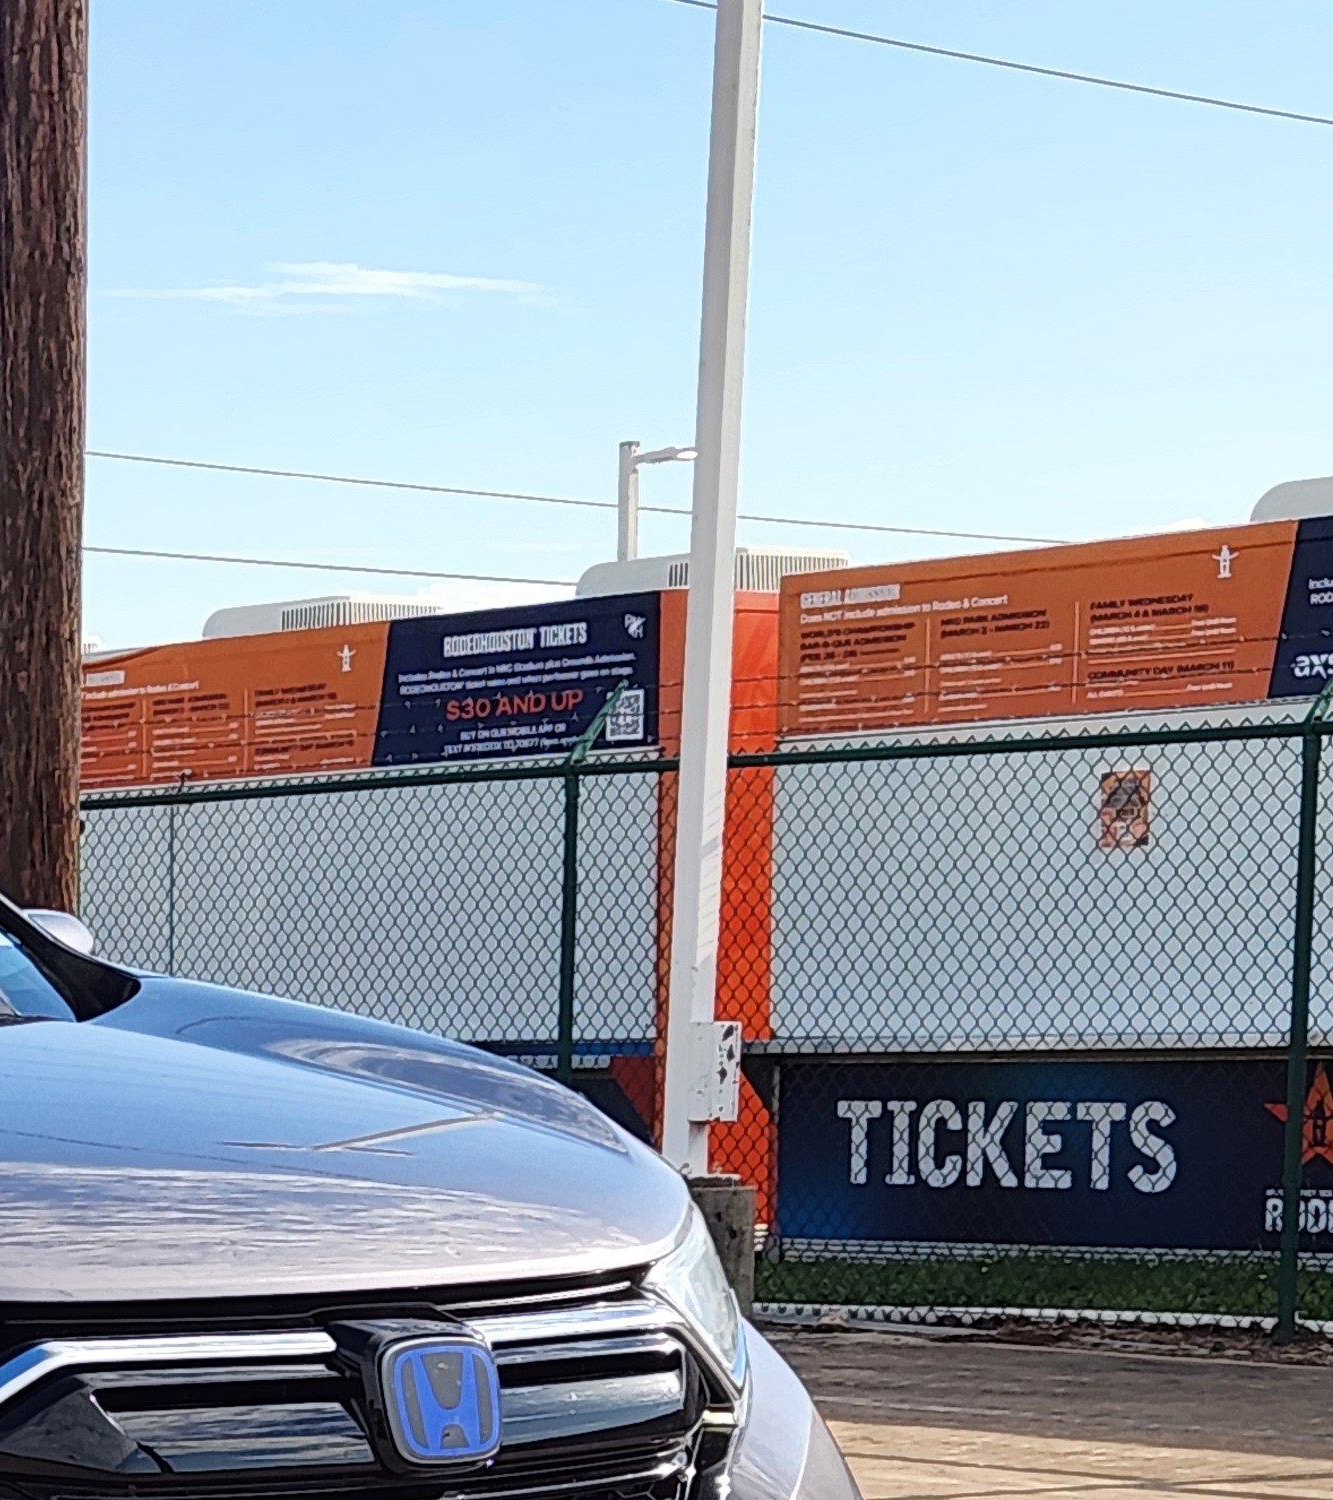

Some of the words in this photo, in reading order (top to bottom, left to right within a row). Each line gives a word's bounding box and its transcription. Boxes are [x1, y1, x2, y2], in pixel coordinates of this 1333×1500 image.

[539, 621, 587, 649] TICKETS
[495, 693, 546, 717] AND
[550, 689, 584, 712] UP
[837, 1099, 1178, 1194] TICKETS
